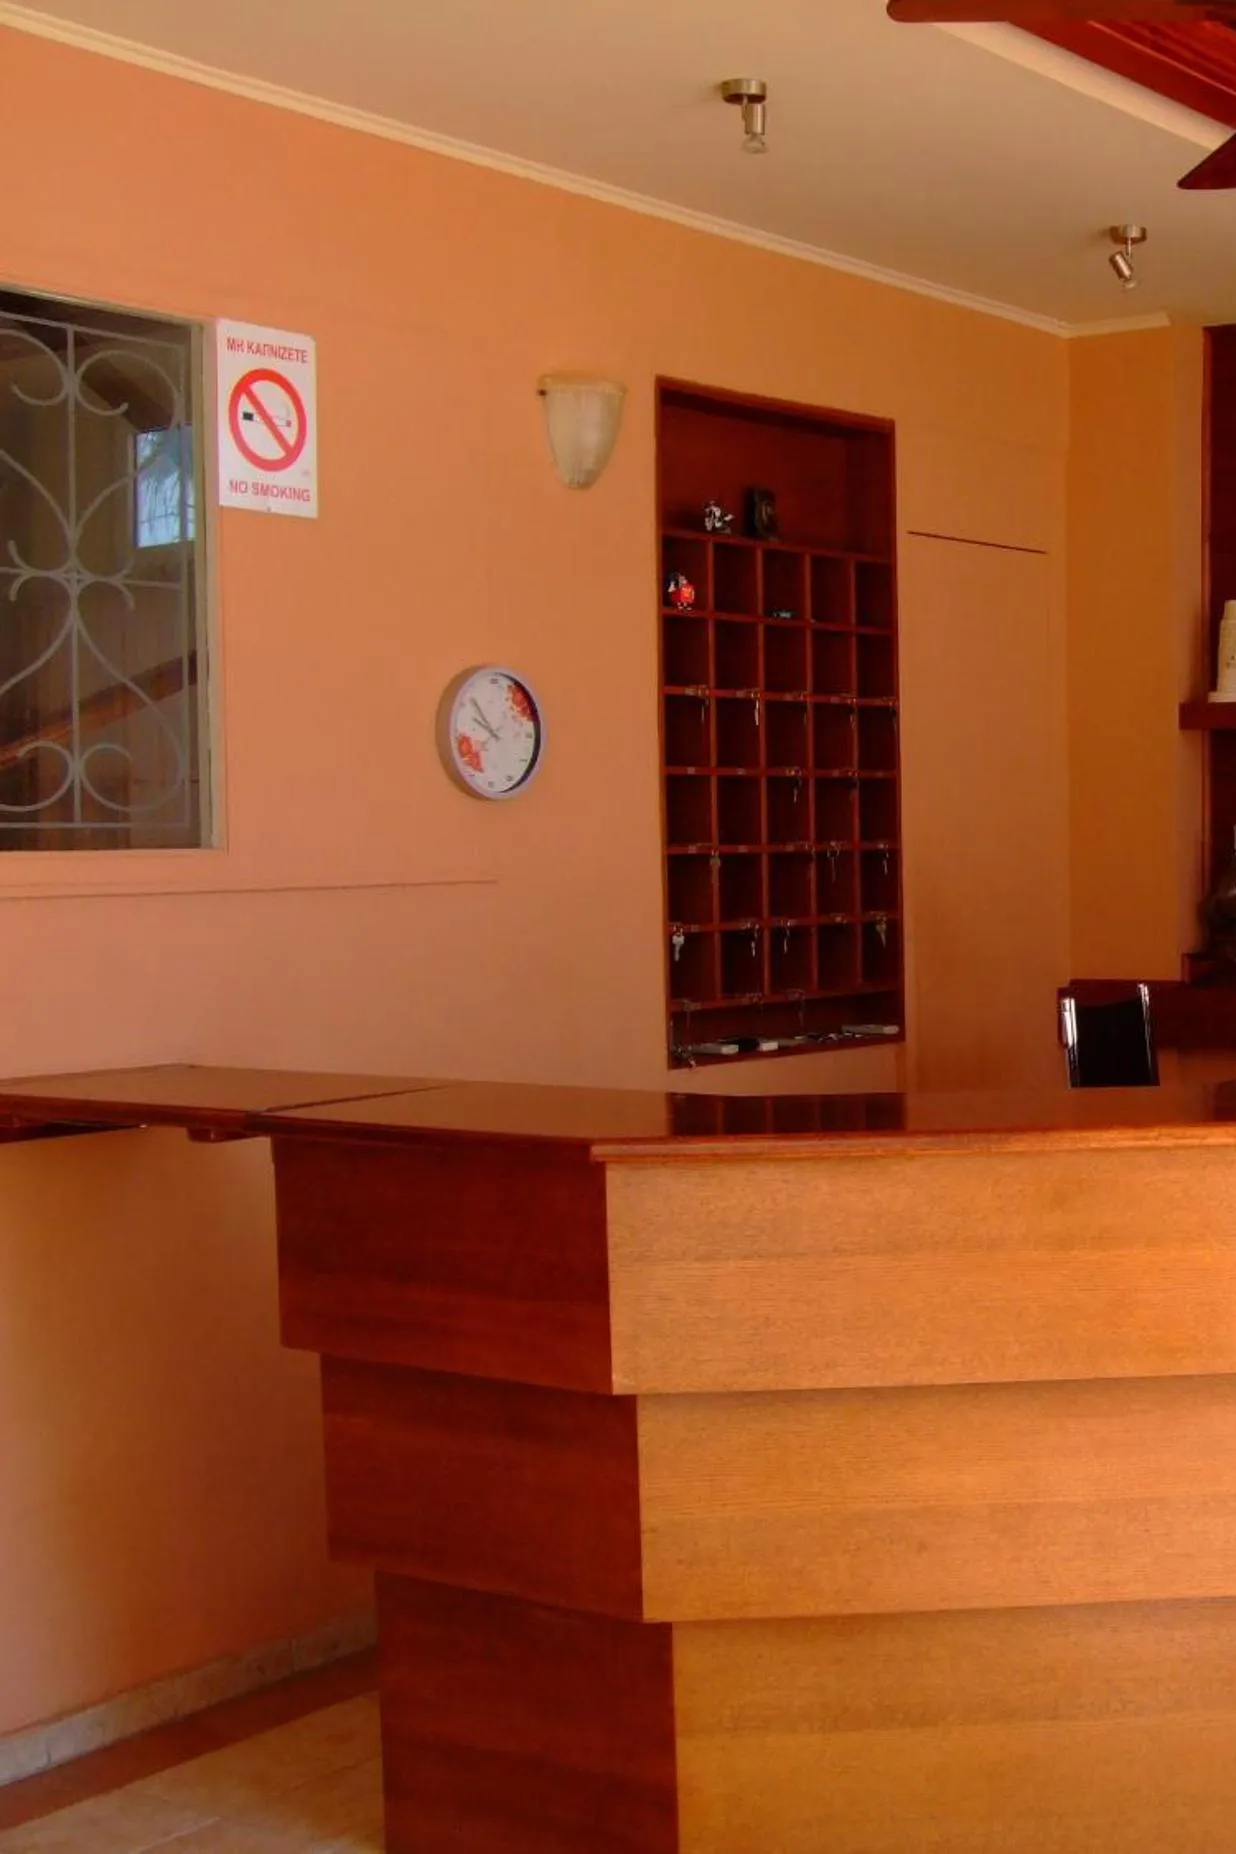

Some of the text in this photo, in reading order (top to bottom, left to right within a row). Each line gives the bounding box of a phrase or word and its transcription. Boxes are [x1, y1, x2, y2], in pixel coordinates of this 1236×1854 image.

[227, 336, 308, 363] ΜΗ ΚΑΠΝΙΖΕΤΕ
[229, 480, 311, 502] NO SMOKING
